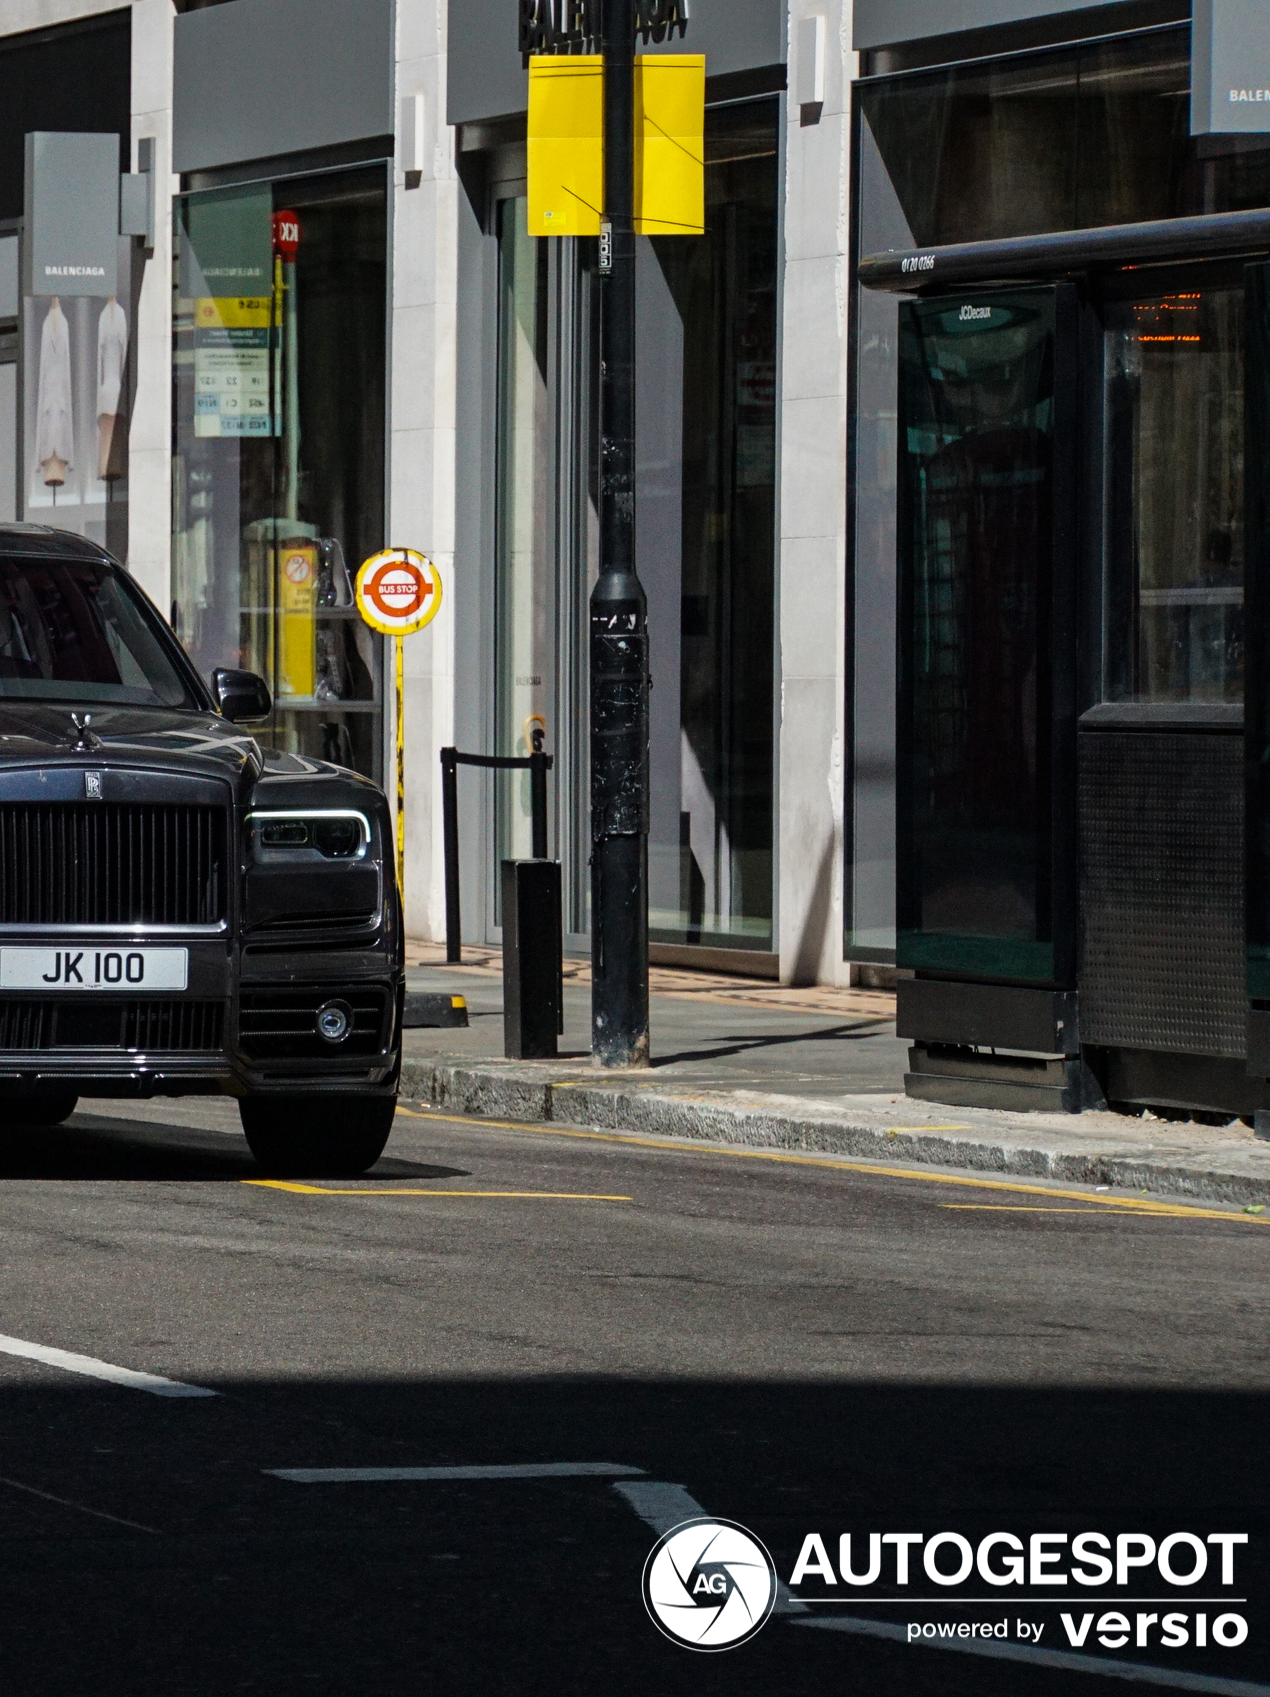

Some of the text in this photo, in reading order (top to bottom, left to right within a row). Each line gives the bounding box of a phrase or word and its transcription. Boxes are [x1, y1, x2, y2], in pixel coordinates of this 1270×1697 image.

[44, 265, 106, 277] BALENCIAGA
[959, 304, 992, 321] JCDecaux
[378, 584, 419, 594] BUS STOP
[42, 952, 145, 983] JK 100
